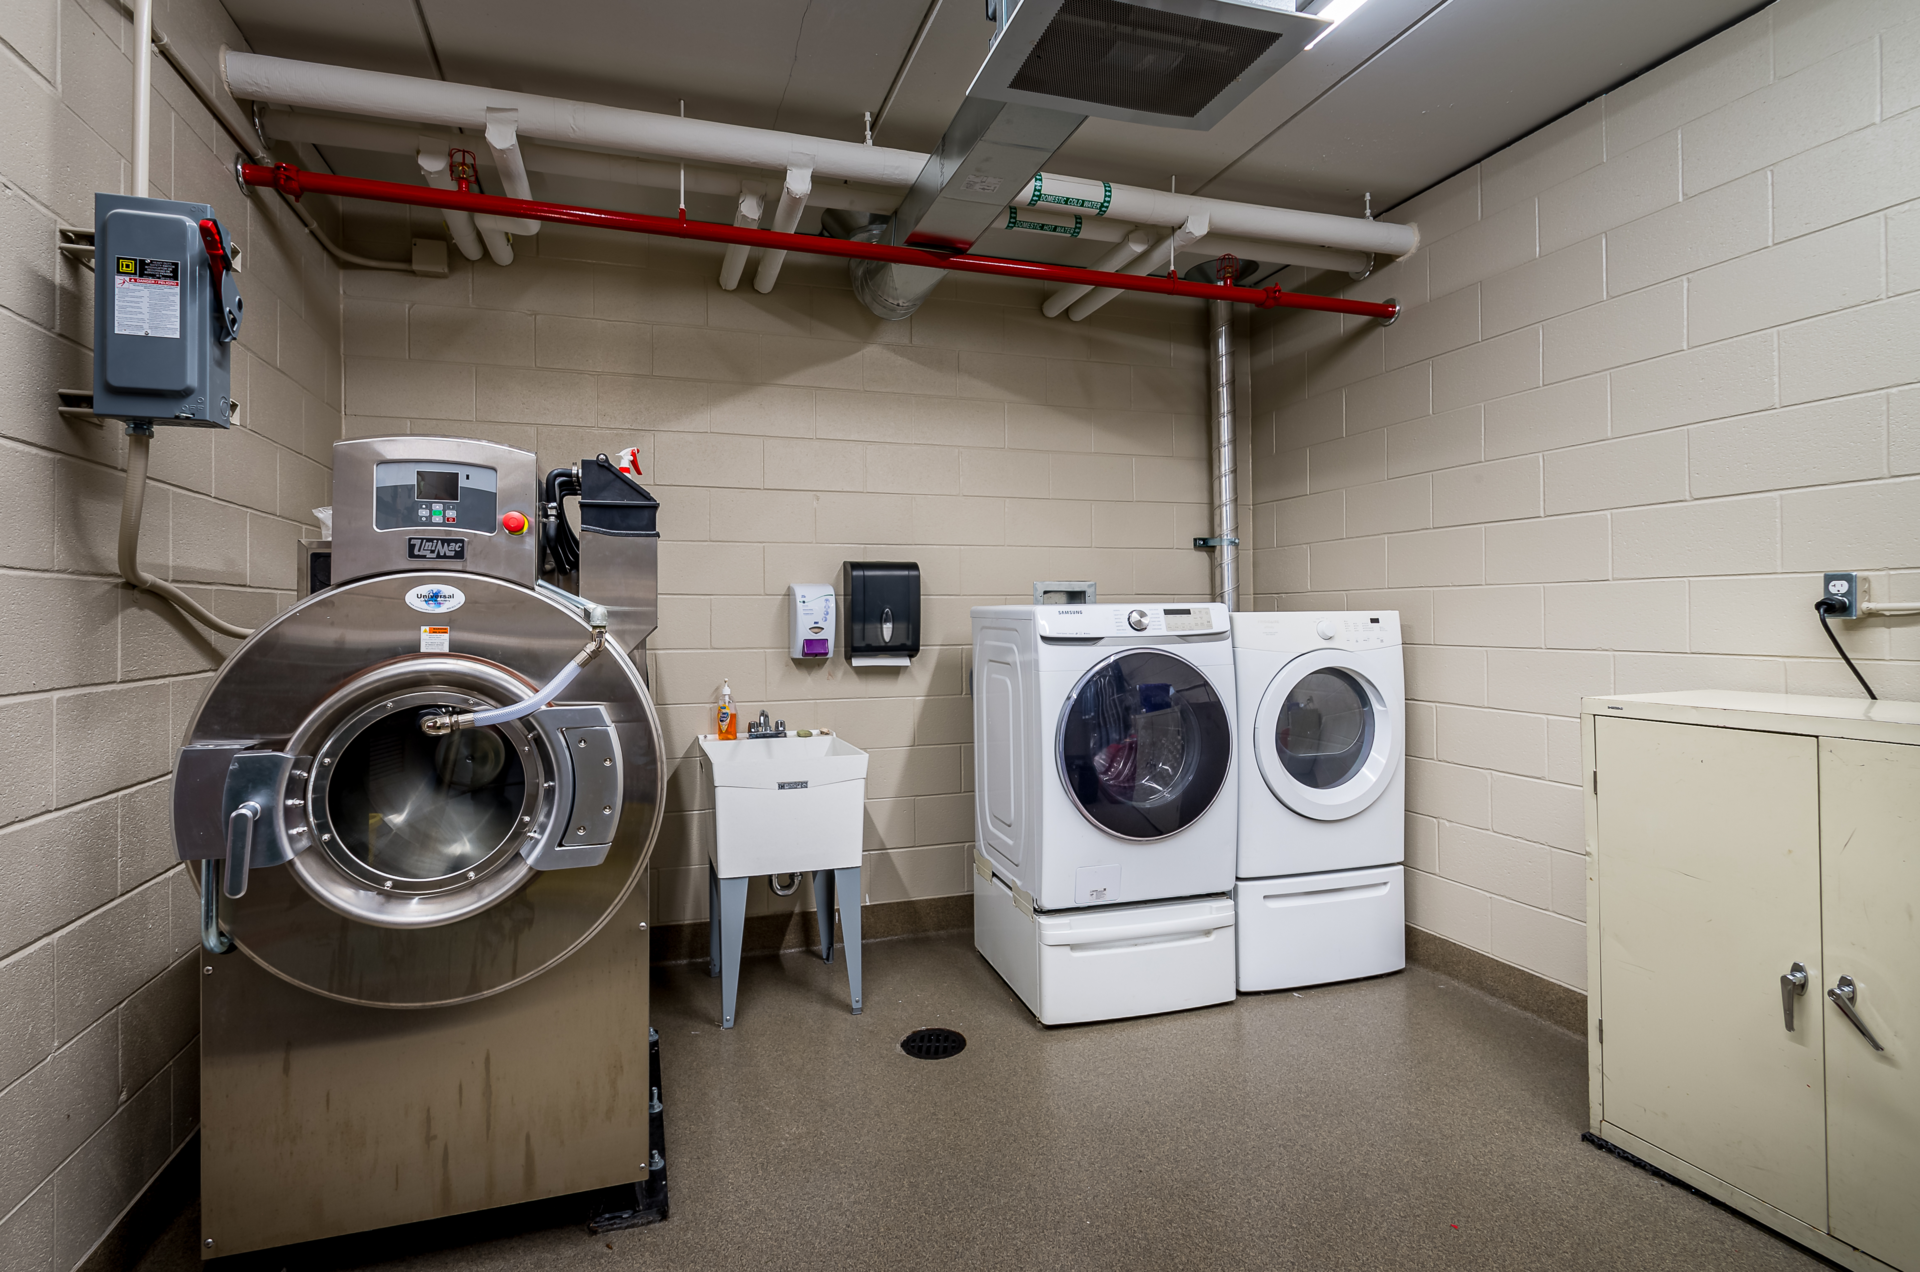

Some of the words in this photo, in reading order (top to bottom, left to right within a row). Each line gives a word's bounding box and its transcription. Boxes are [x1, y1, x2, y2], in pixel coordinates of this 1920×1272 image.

[1040, 194, 1066, 205] DOMESTIC
[1067, 198, 1082, 207] COLD
[1083, 200, 1102, 209] WATER
[1015, 220, 1042, 230] DOMESTIC
[1044, 224, 1054, 232] HOT
[1056, 226, 1075, 234] WATER
